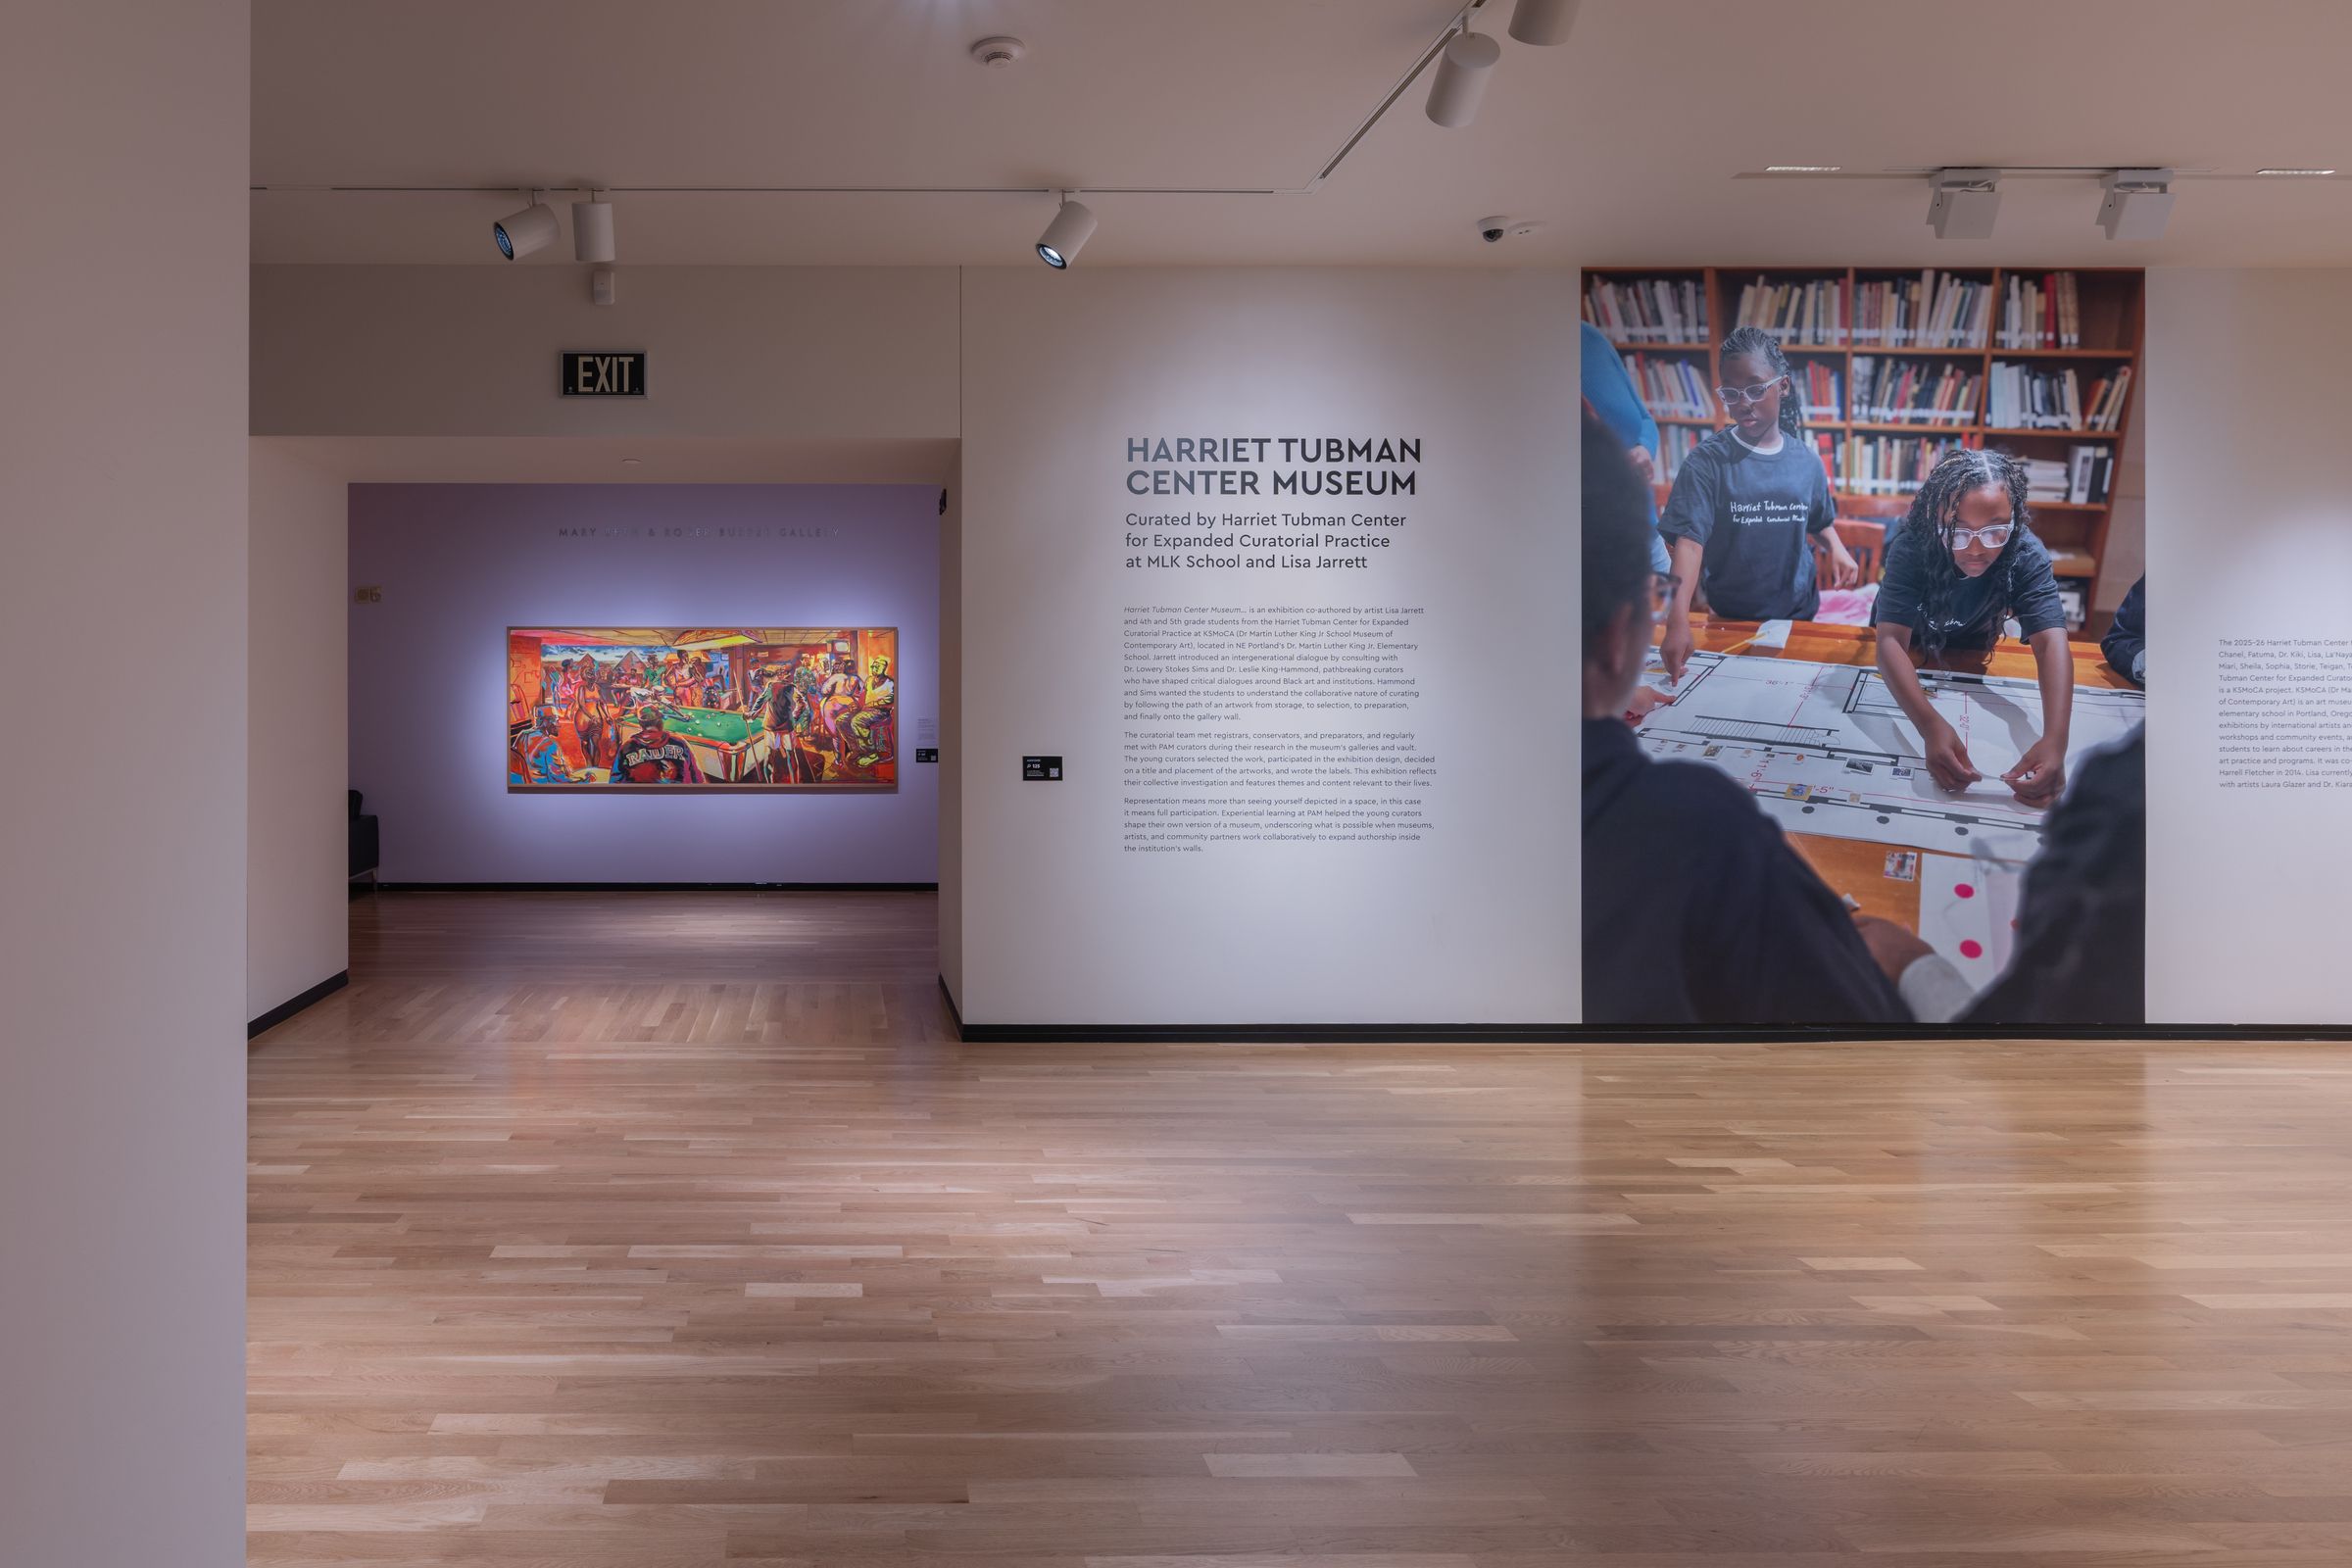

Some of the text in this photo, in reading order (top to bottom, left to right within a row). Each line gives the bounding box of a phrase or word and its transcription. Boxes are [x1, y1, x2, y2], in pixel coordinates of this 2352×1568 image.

[578, 356, 634, 393] EXIT
[1128, 438, 1420, 463] HARRIET TUBMAN
[1127, 470, 1415, 495] CENTER MUSEUM
[1730, 501, 1762, 513] Harriet
[1126, 512, 1406, 528] Curated by Harriet Tubman Center
[1126, 533, 1390, 550] for Expanded Curatorial Practice
[1126, 554, 1367, 568] at MLK School and Lisa Jarrett
[1353, 606, 1362, 614] by
[1184, 617, 1205, 626] grade
[1372, 617, 1408, 626] Expanded
[1124, 641, 1177, 650] Contemporary
[1179, 641, 1195, 650] Art),
[1349, 641, 1365, 650] King
[1377, 641, 1418, 650] Elementary
[1137, 665, 1163, 674] Lowery
[1323, 665, 1371, 674] pathbreaking
[1140, 712, 1161, 721] finally
[1198, 712, 1222, 721] gallery
[1214, 731, 1250, 740] registrars,
[1252, 731, 1301, 740] conservators,
[1320, 731, 1364, 740] preparators,
[1383, 731, 1415, 740] regularly
[1124, 797, 1180, 806] Representation
[1248, 797, 1272, 806] seeing
[1273, 797, 1302, 806] yourself
[1303, 797, 1338, 806] depicted
